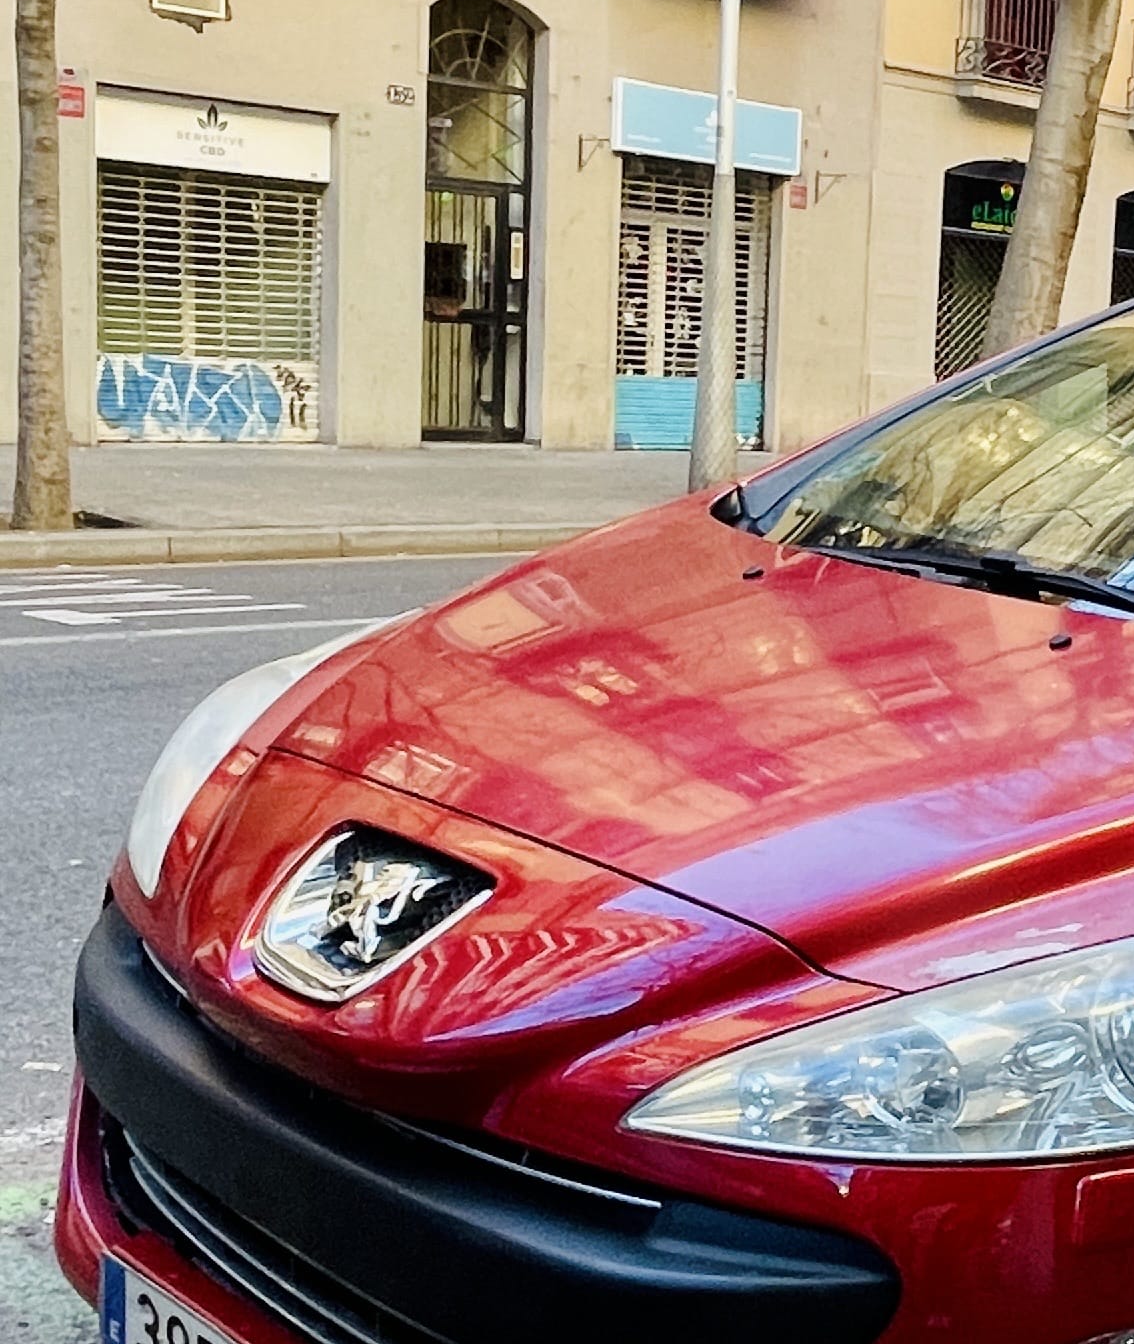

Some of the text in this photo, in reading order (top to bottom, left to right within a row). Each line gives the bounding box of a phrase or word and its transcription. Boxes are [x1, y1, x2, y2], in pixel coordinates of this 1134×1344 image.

[199, 144, 226, 157] CBD
[972, 200, 1016, 226] eLaic
[109, 1318, 121, 1344] E
